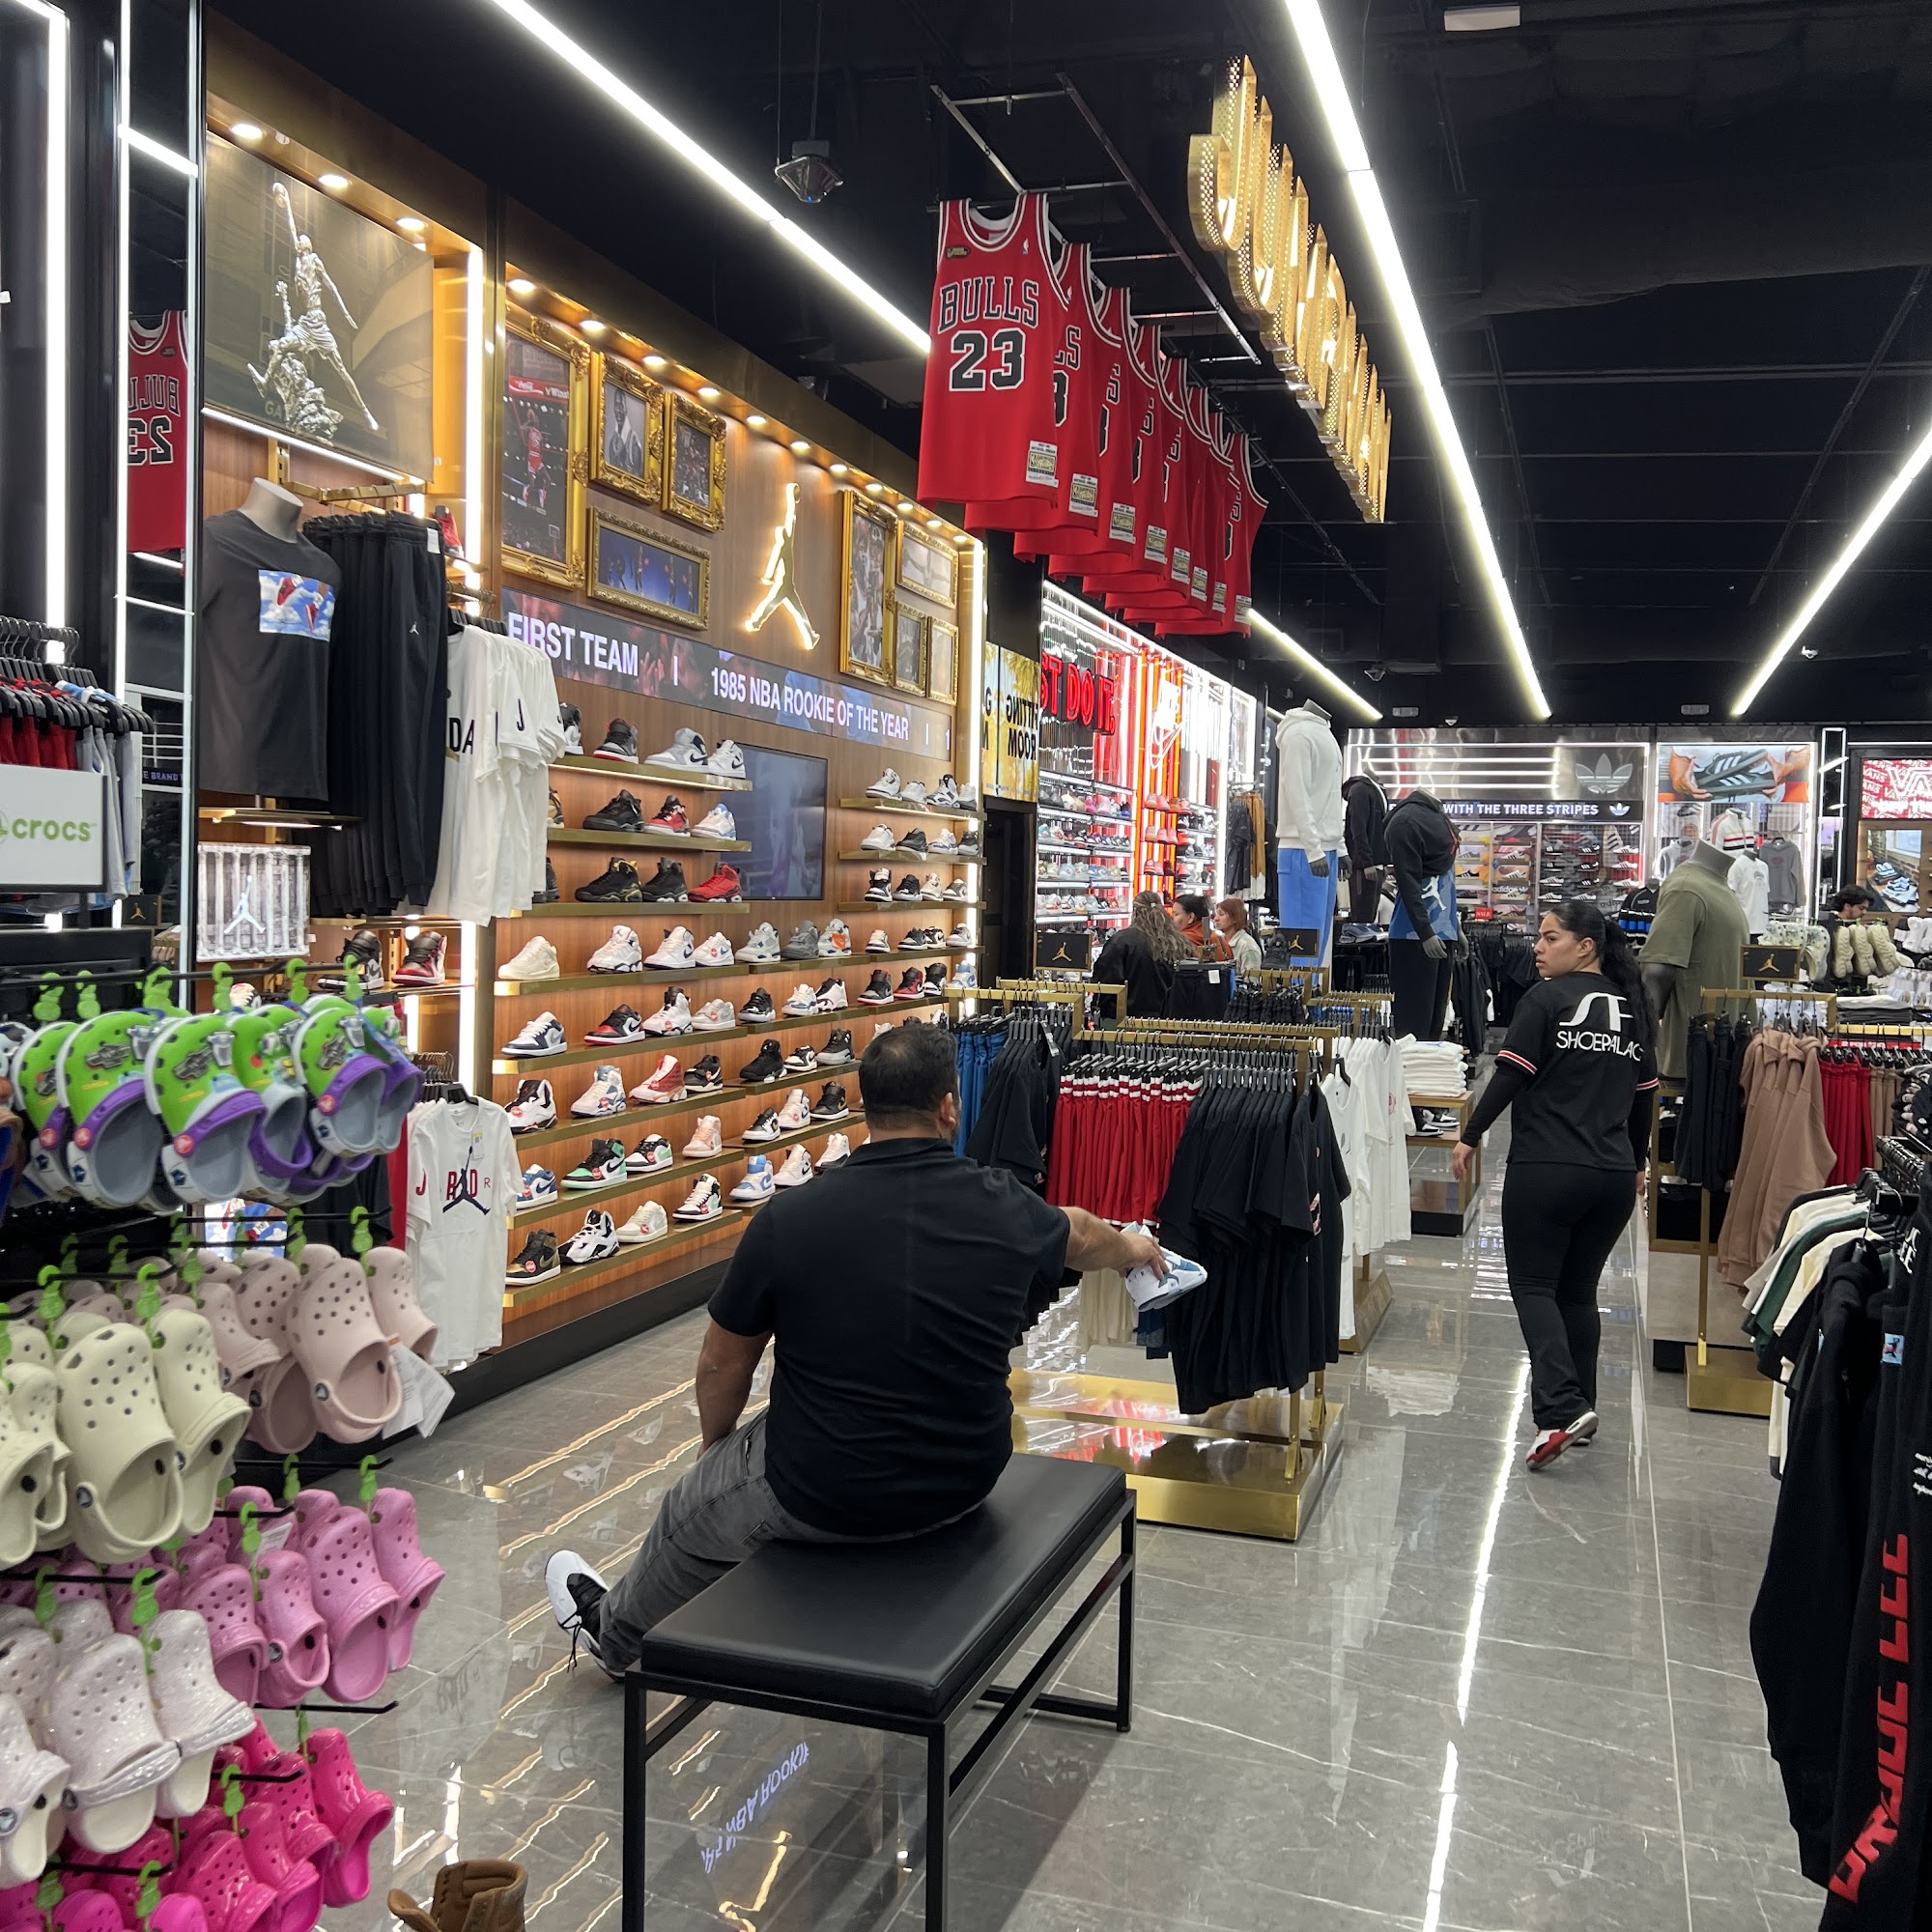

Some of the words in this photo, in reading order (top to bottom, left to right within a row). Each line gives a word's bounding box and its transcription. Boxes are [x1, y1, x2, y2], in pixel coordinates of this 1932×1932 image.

[938, 276, 1039, 334] BULLS
[949, 327, 1026, 391] 23
[508, 611, 575, 661] FIRST
[580, 631, 639, 676] TEAM
[711, 668, 747, 703] 1985
[750, 677, 781, 712] NBA
[783, 687, 835, 724] ROOKIE
[837, 700, 854, 726] OF
[856, 705, 879, 733] THE
[880, 712, 909, 741] YEAR
[1065, 664, 1094, 726] DO
[12, 818, 91, 842] crocs
[1443, 803, 1474, 814] WITH
[1477, 804, 1500, 814] THE
[1504, 804, 1544, 814] THREE
[1547, 804, 1599, 815] STRIPES
[1556, 1030, 1644, 1062] SHOEPALAC
